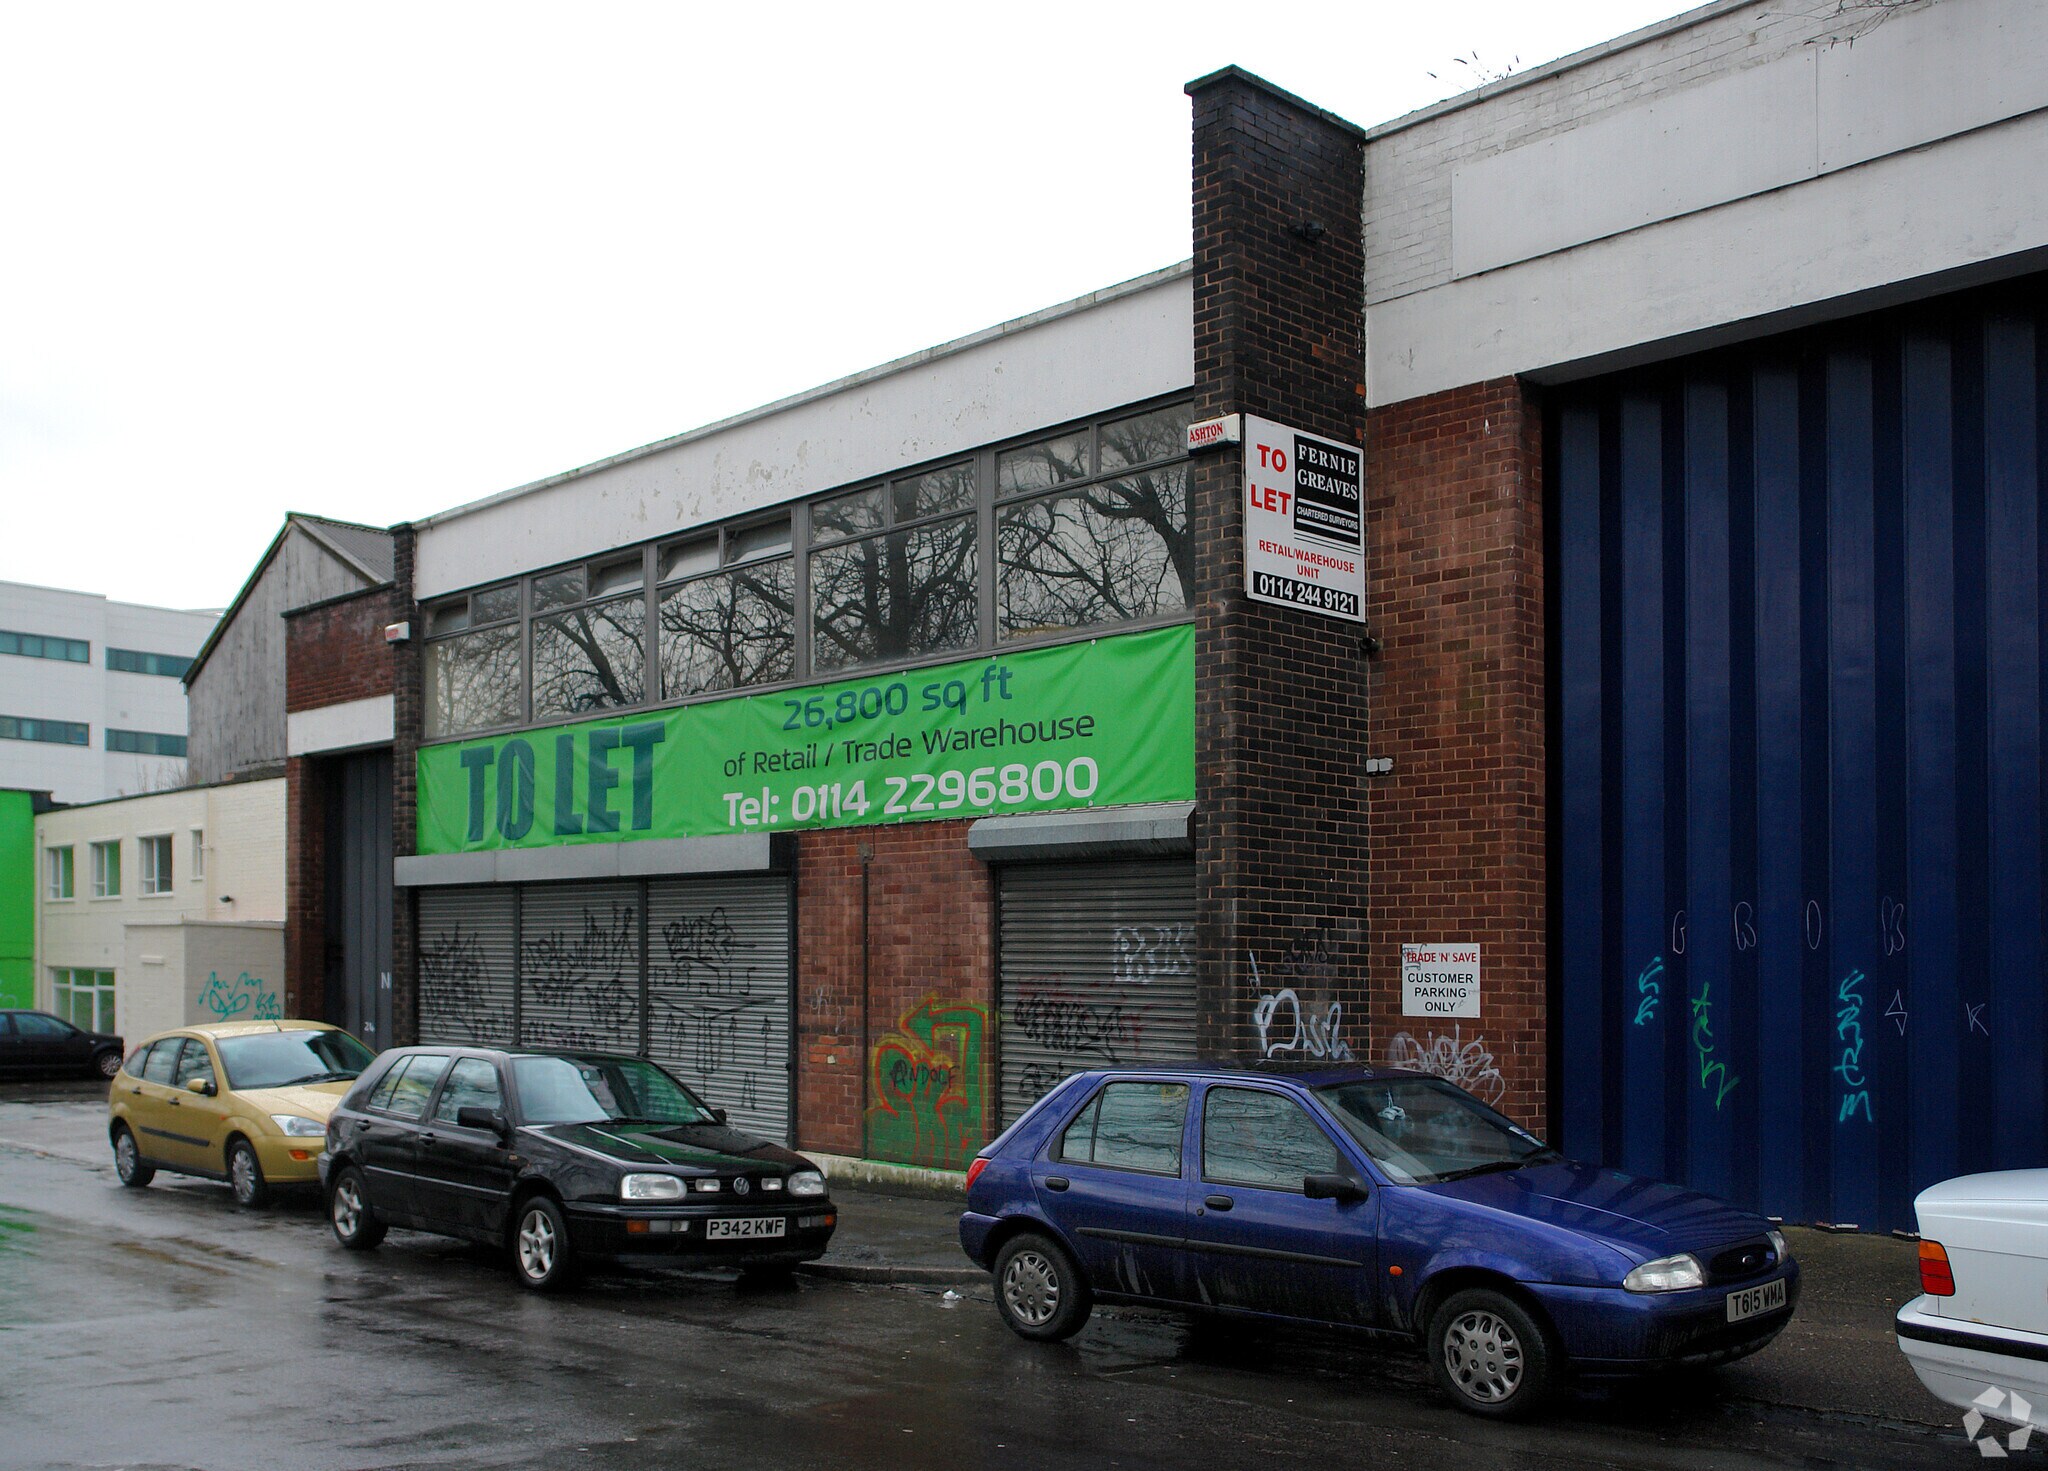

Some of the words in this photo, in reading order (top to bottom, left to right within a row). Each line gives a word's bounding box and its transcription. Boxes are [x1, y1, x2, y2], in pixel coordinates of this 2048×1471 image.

[1189, 422, 1224, 442] ASHTON
[1256, 443, 1287, 472] TO
[1298, 443, 1357, 476] FERNIE
[1250, 483, 1291, 515] LET
[1297, 468, 1358, 500] GREAVES
[1296, 505, 1328, 521] CHARTERED
[1329, 514, 1358, 530] SURVEYORS
[1259, 539, 1355, 573] RETAIL/WAREHOUSE
[1297, 564, 1320, 579] UNIT
[1260, 574, 1294, 600] 0114
[1296, 582, 1322, 606] 244
[1324, 589, 1354, 614] 9121
[783, 682, 908, 731] 26,800
[921, 679, 967, 715] sq
[981, 664, 1013, 703] ft
[724, 751, 747, 777] of
[753, 741, 817, 774] Retail
[824, 741, 832, 768] /
[841, 731, 912, 763] Trade
[921, 714, 1095, 755] Warehouse
[460, 738, 535, 842] TO
[554, 720, 666, 836] LET
[723, 786, 779, 827] Tel:
[791, 779, 870, 821] 0114
[884, 756, 1099, 814] 2296800
[1406, 952, 1436, 963] TRADE
[1452, 952, 1477, 963] SAVE
[1407, 973, 1473, 984] CUSTOMER
[1414, 987, 1467, 998] PARKING
[1425, 1001, 1456, 1012] ONLY
[709, 1221, 751, 1236] P342
[754, 1219, 785, 1235] KWF
[1733, 1289, 1760, 1316] T615
[1763, 1283, 1784, 1307] WMA
